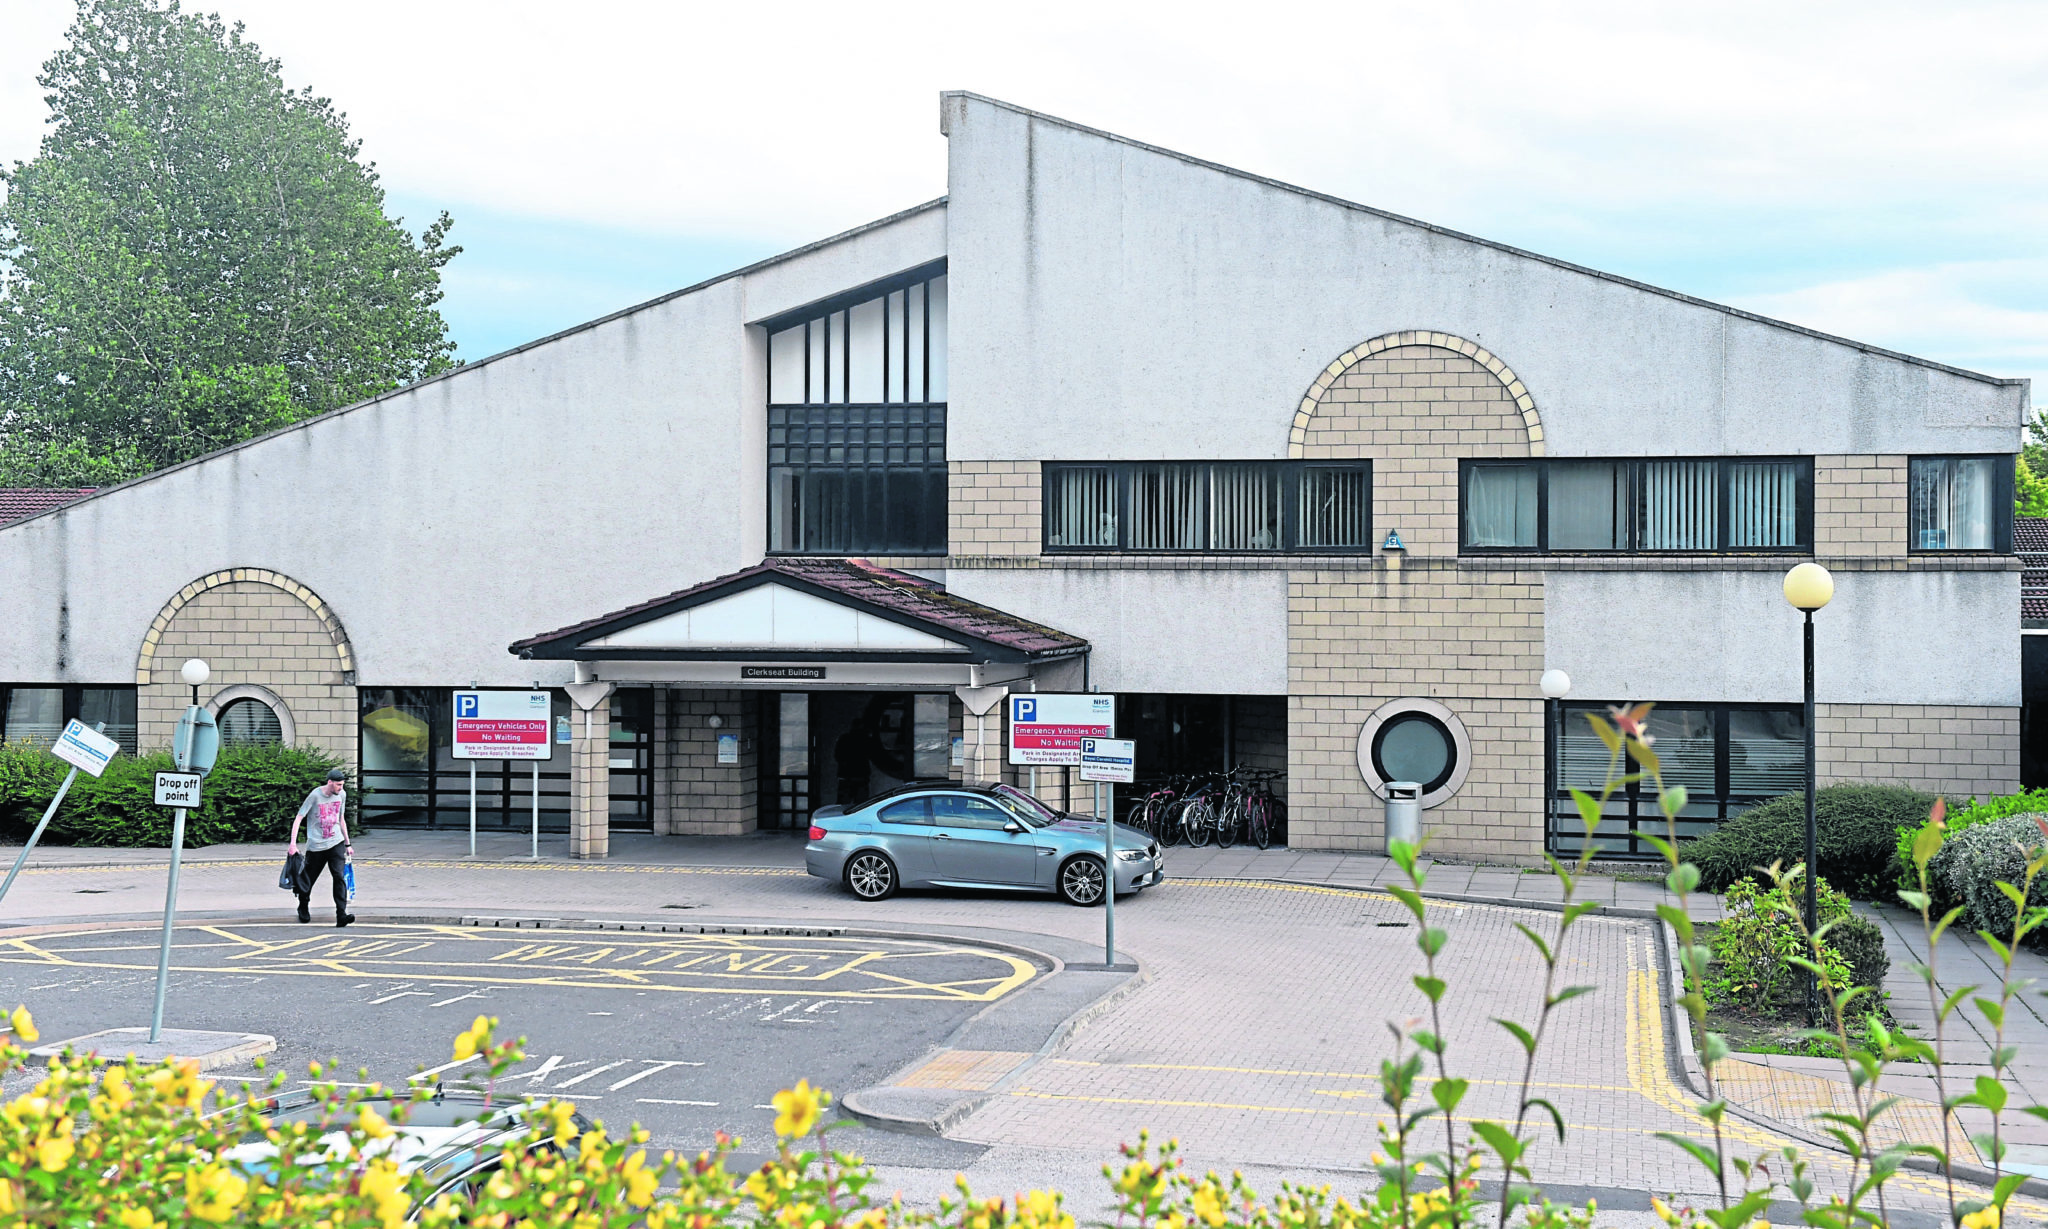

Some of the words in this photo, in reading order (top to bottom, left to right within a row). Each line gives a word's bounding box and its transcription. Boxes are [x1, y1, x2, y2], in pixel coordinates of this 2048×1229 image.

[788, 668, 819, 677] Building
[461, 697, 475, 716] P
[1018, 700, 1034, 720] P
[70, 724, 81, 735] P
[458, 722, 496, 730] Emergency
[1086, 741, 1094, 752] P
[160, 777, 182, 790] Drop
[184, 779, 197, 789] off
[166, 792, 189, 801] point
[289, 938, 436, 958] NO
[487, 944, 830, 974] WAITING
